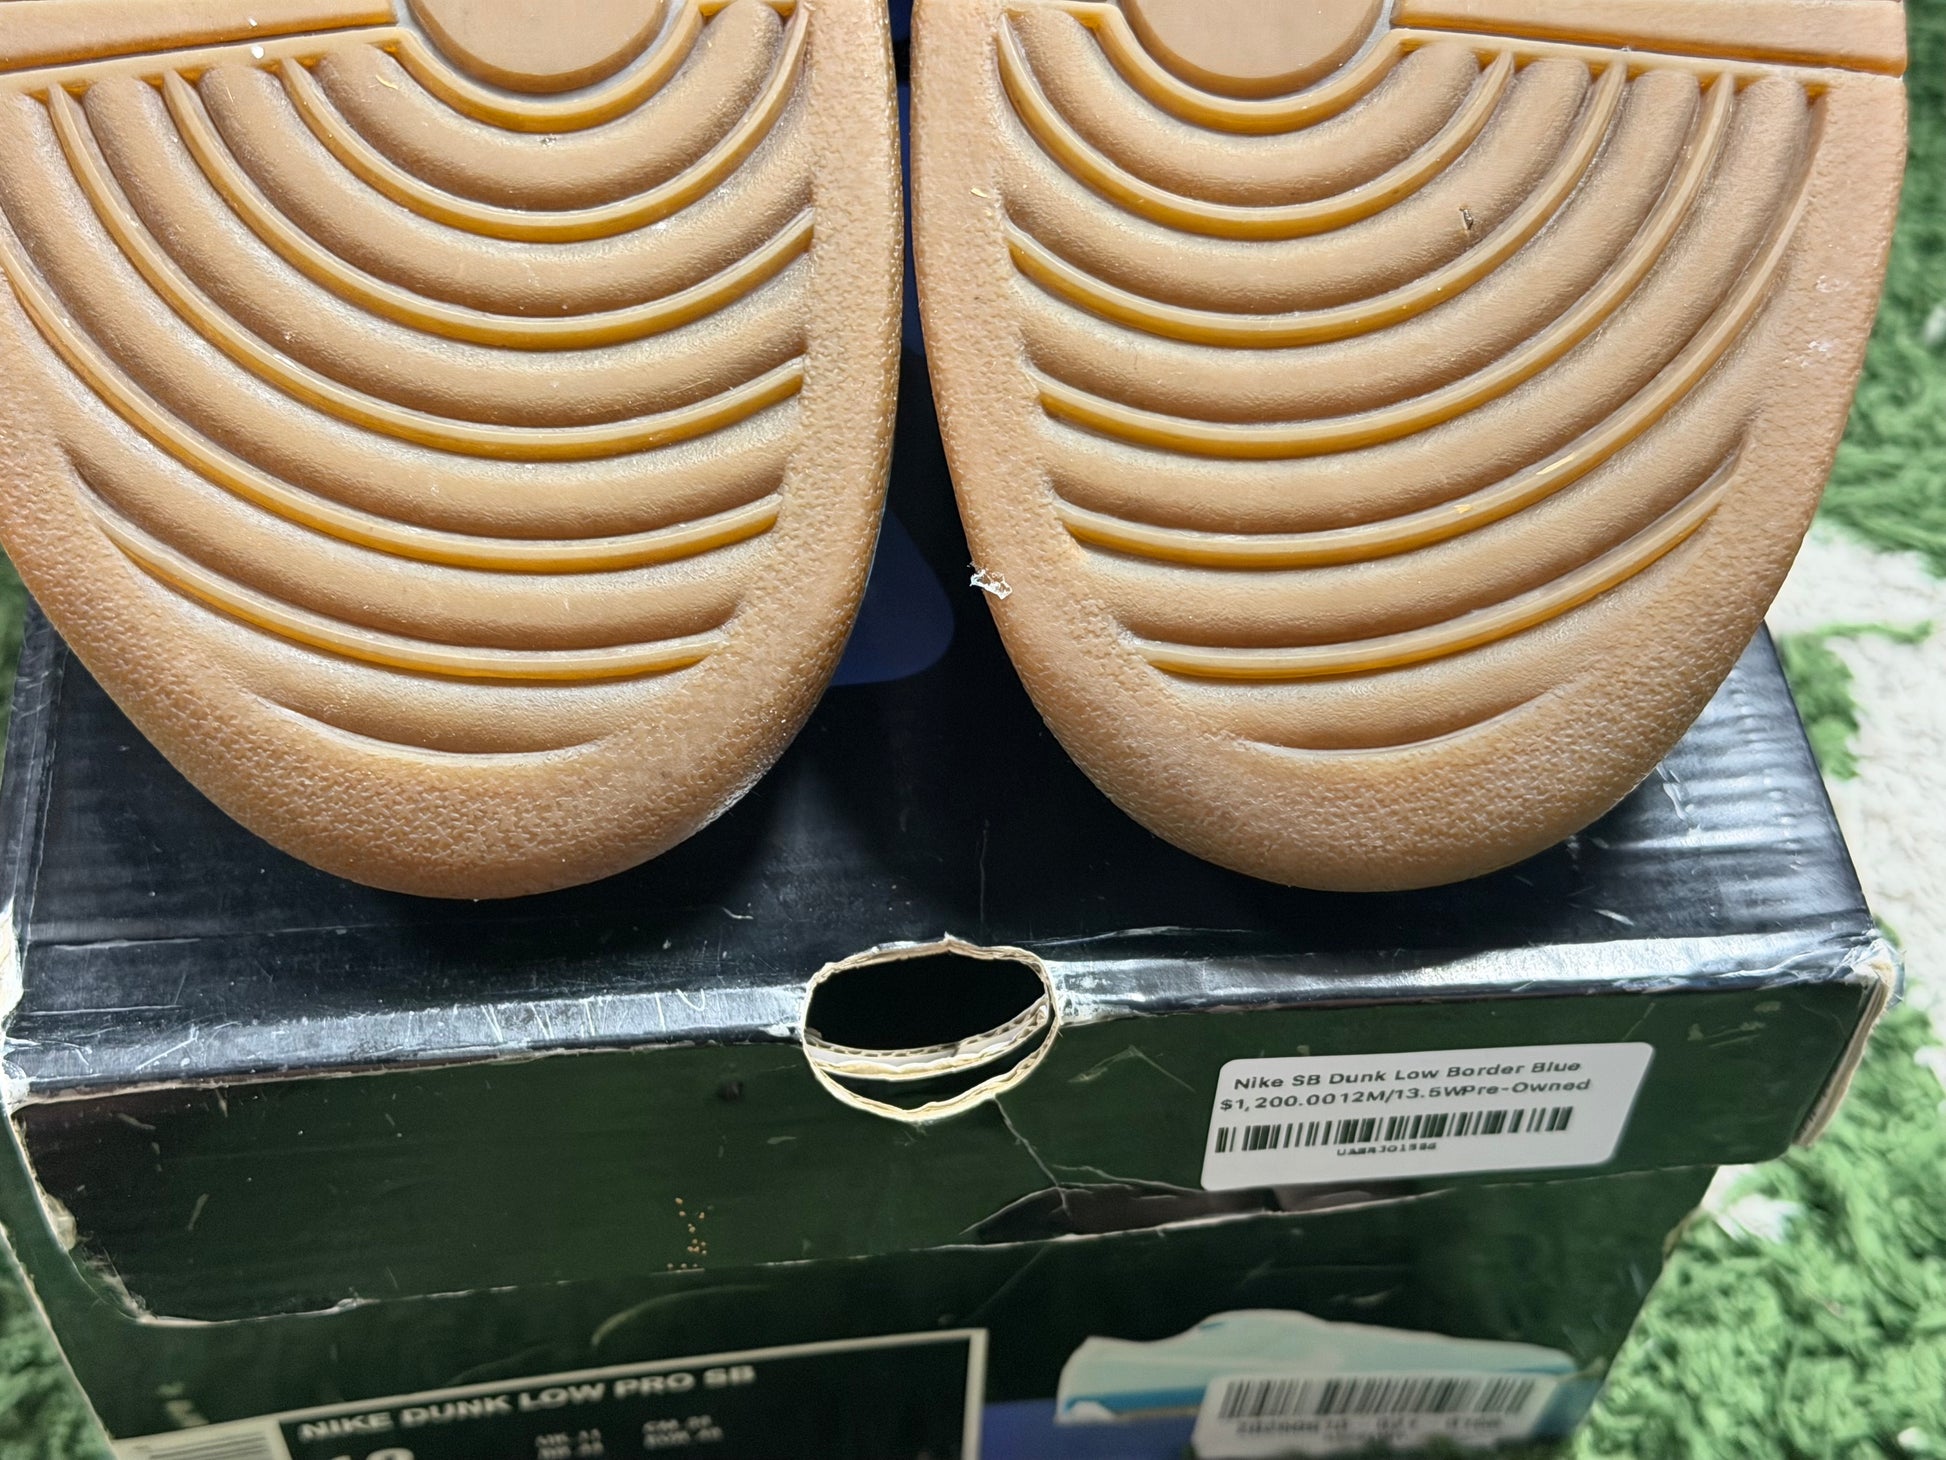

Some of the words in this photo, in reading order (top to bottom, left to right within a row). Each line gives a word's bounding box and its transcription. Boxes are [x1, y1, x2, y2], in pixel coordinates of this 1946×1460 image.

[1234, 1076, 1284, 1090] Nike
[1291, 1074, 1321, 1086] SB
[1328, 1070, 1387, 1085] Dunk
[1394, 1069, 1440, 1081] Low
[1446, 1063, 1525, 1078] Border
[1531, 1061, 1582, 1073] Blue
[298, 1411, 393, 1441] NIKE
[399, 1395, 512, 1427] DUNK
[518, 1382, 606, 1411] LOW
[613, 1372, 696, 1399] PRO
[702, 1364, 756, 1387] SB
